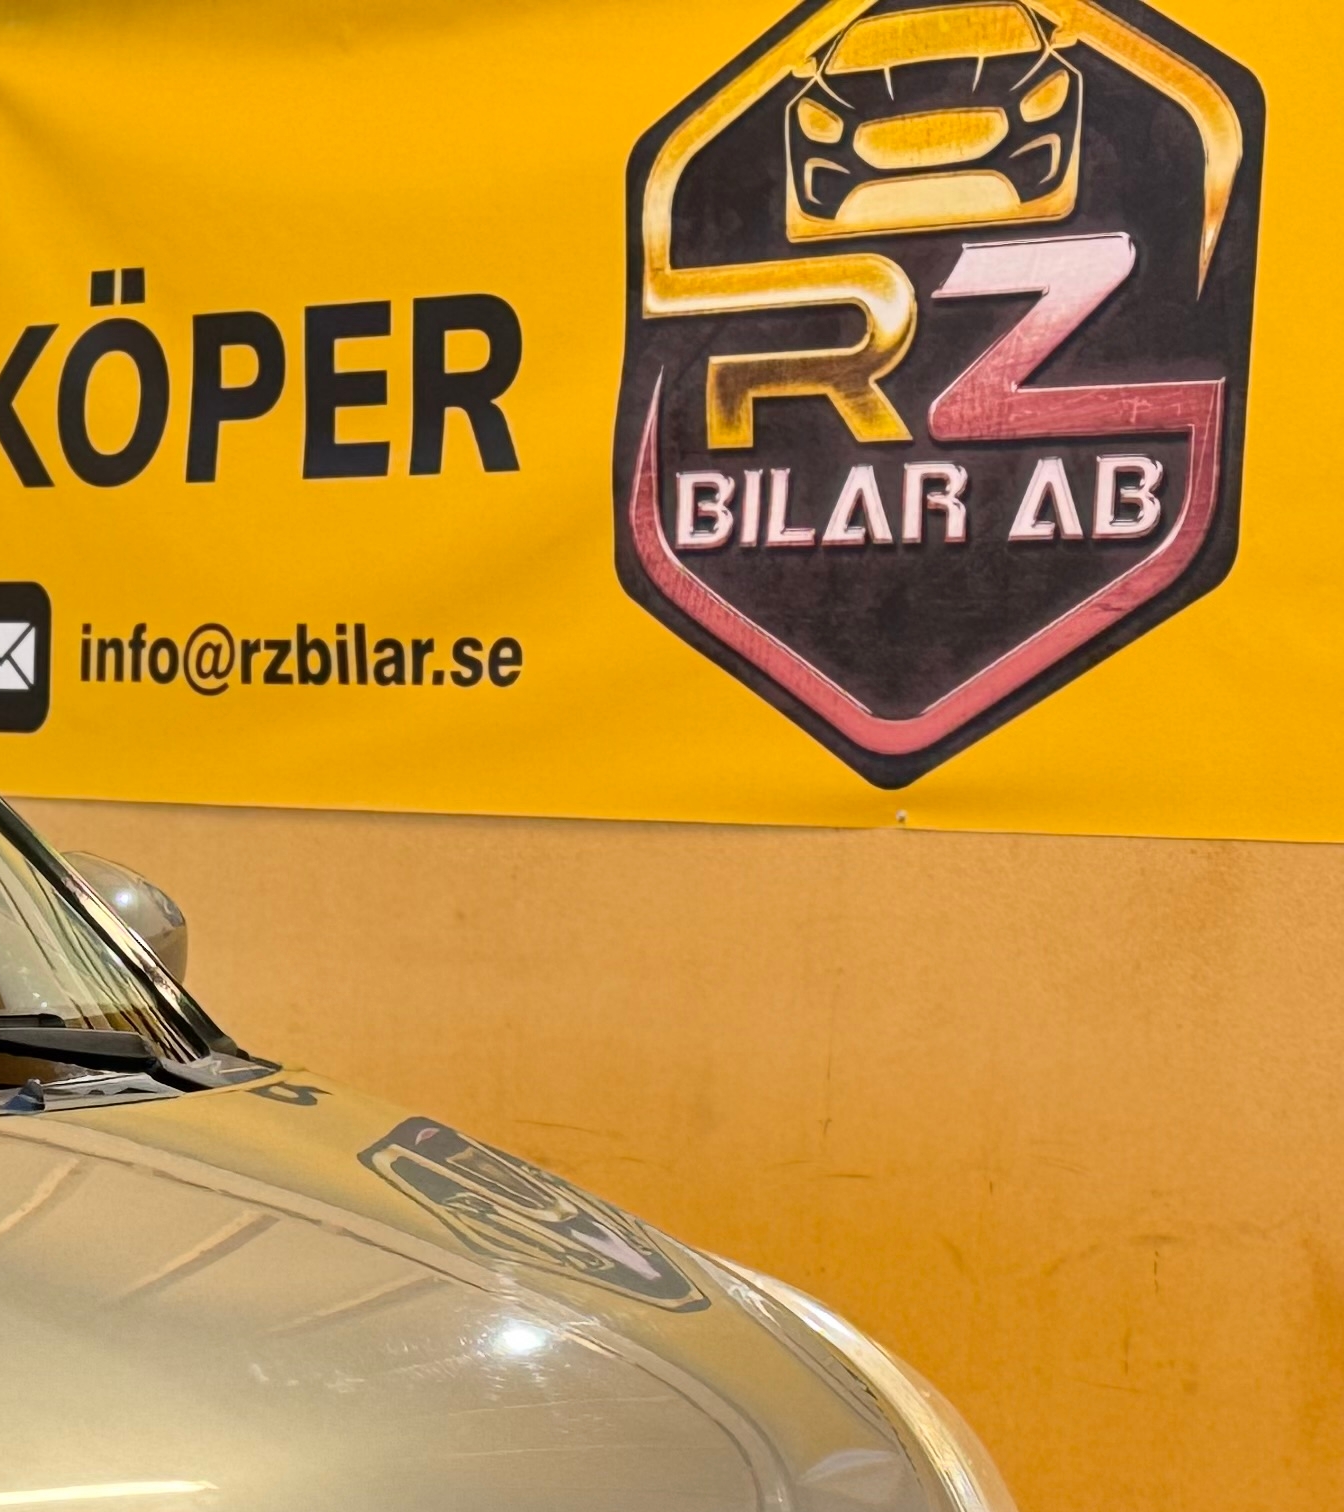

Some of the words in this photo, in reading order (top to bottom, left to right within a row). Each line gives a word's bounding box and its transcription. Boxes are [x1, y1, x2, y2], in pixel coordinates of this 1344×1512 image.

[643, 232, 1225, 449] RZ
[674, 460, 968, 550] BILAR
[1008, 454, 1164, 544] AB
[79, 622, 523, 696] info@rzbilar.se
